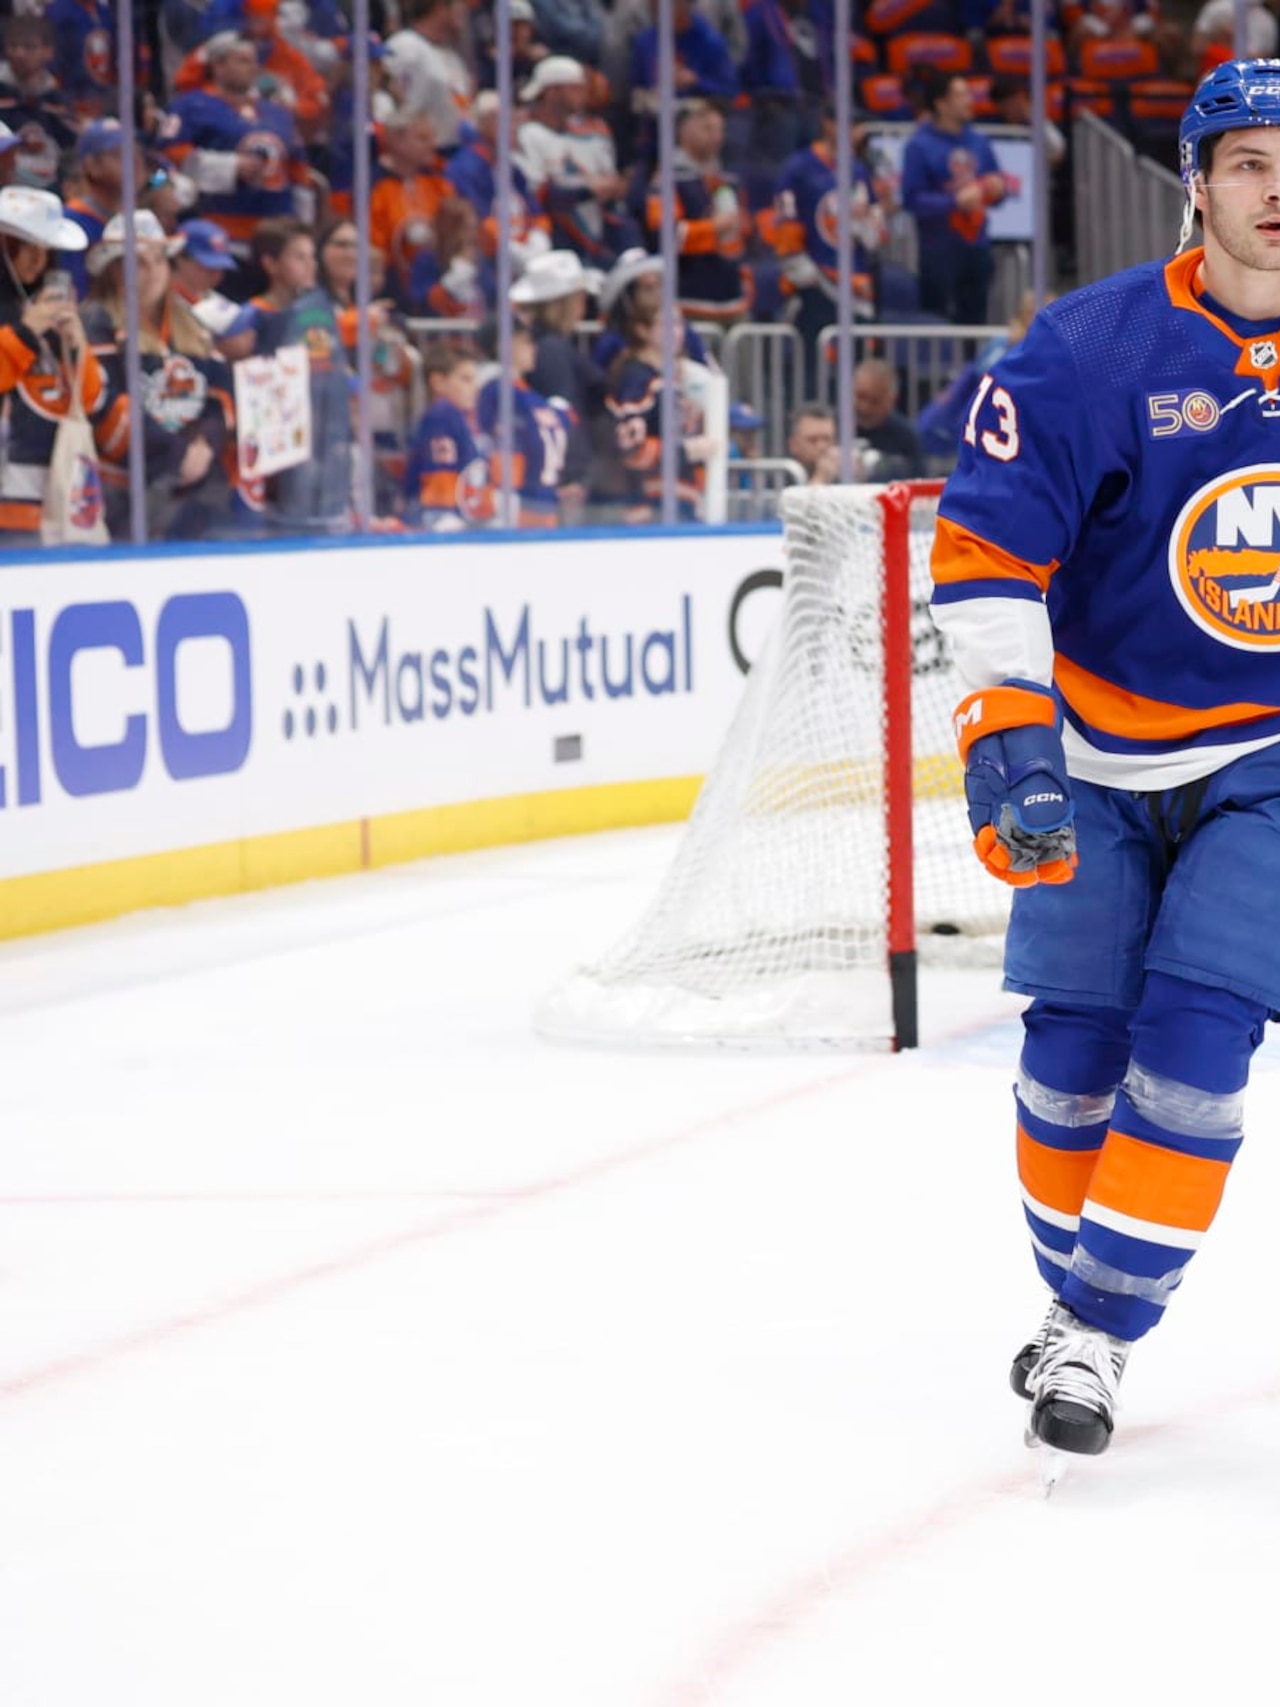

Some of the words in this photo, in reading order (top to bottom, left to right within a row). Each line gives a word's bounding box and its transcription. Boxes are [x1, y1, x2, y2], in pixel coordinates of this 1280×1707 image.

[964, 373, 1020, 462] 13
[1149, 391, 1220, 437] 50
[0, 591, 253, 806] ICO
[348, 593, 694, 730] MassMutual
[1023, 792, 1064, 807] CCM
